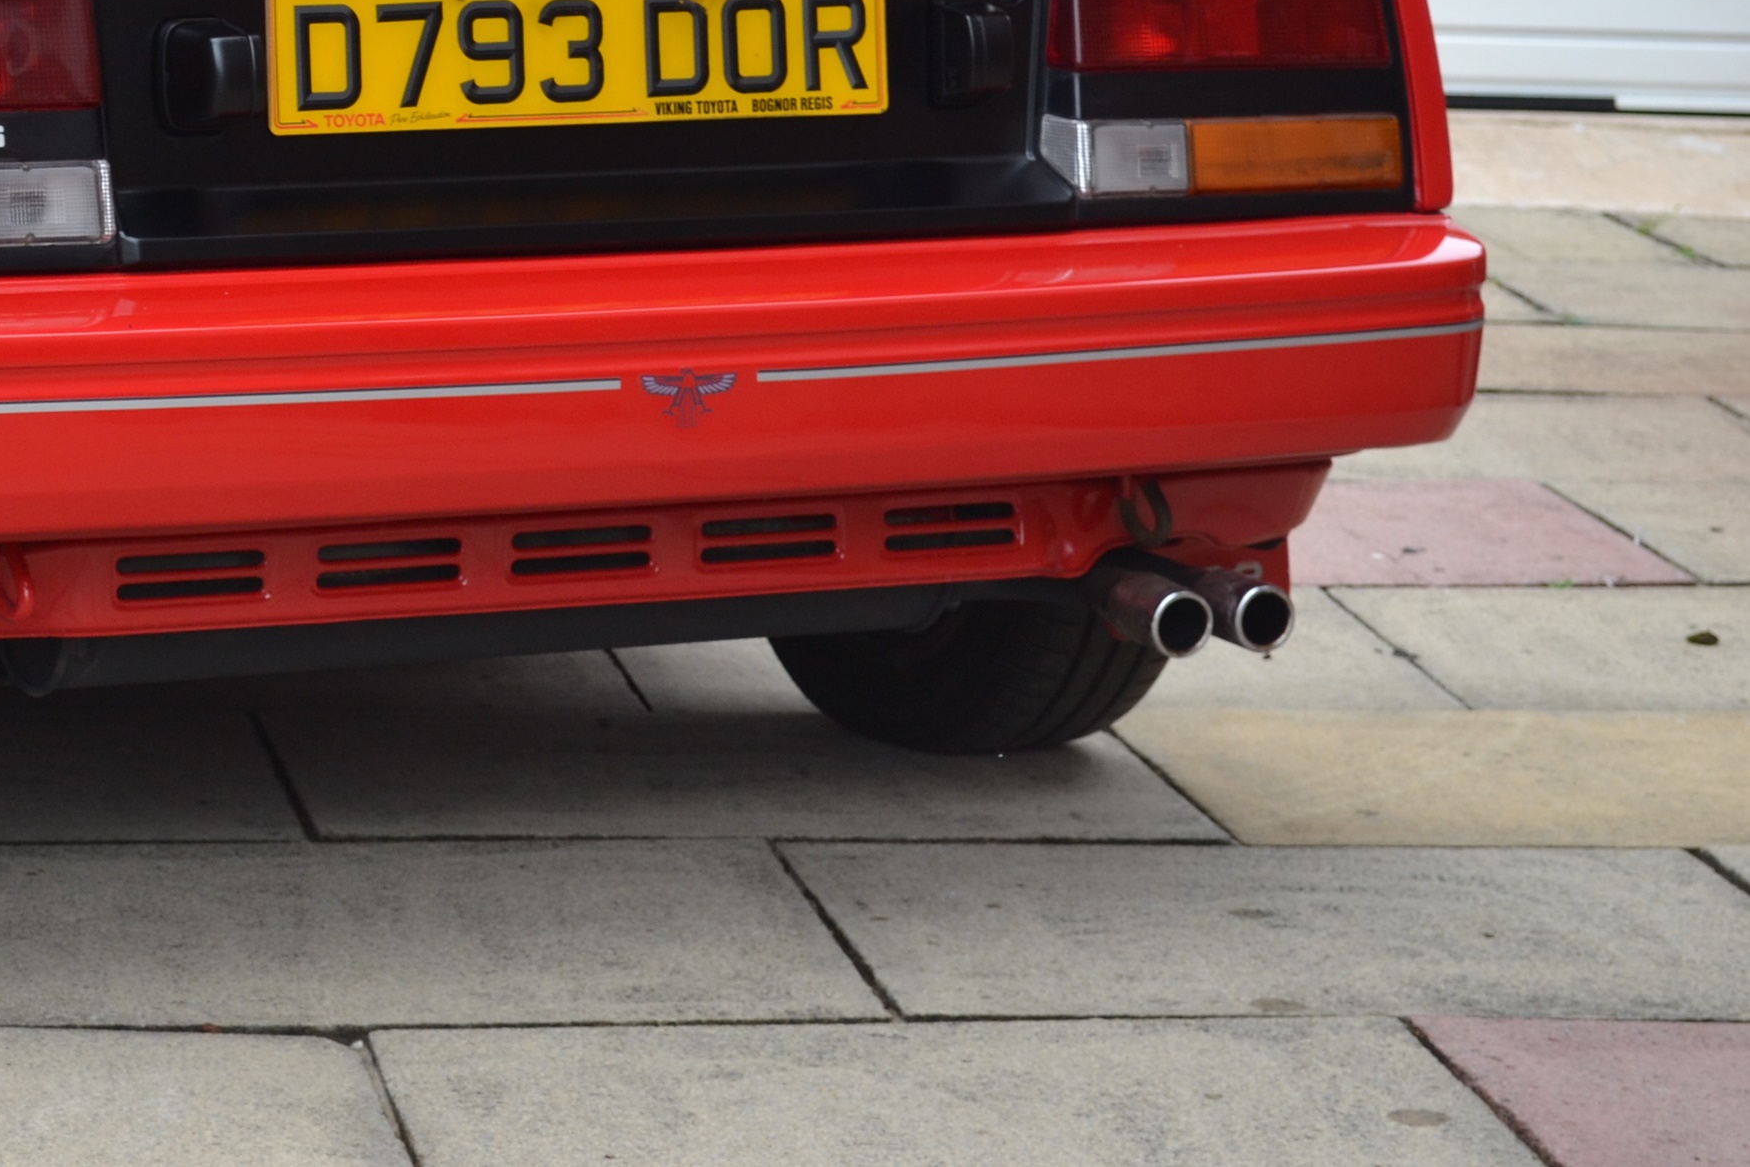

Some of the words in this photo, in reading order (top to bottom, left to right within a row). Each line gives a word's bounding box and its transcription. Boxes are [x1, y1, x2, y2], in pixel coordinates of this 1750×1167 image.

[654, 101, 693, 116] VIKING
[695, 99, 739, 115] TOYOTA
[751, 97, 798, 112] BOGNOR
[800, 96, 834, 111] REGIS
[323, 113, 386, 128] TOYOTA
